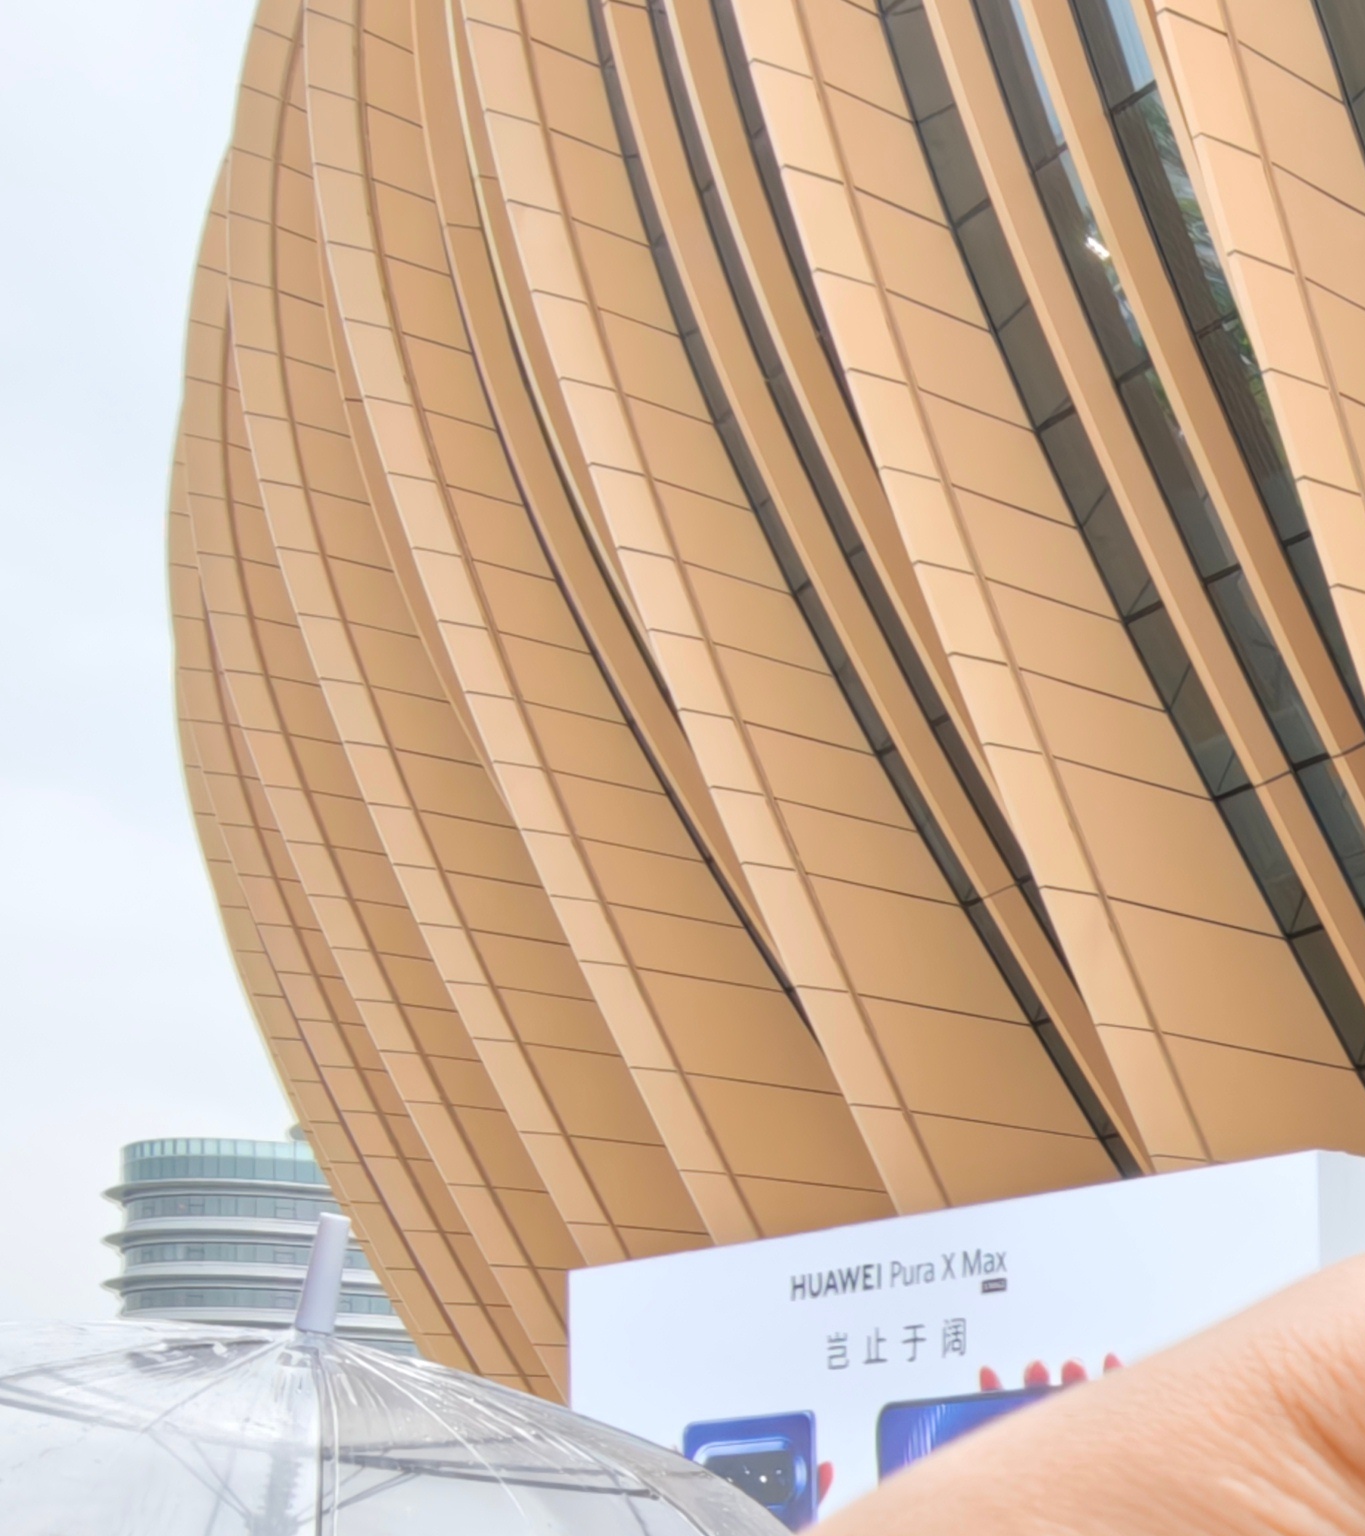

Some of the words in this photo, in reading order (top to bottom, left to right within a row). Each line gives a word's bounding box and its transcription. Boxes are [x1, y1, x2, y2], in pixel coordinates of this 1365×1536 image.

[790, 1263, 882, 1301] HUAWEI
[890, 1261, 935, 1287] Pura
[941, 1252, 956, 1281] X
[961, 1248, 1007, 1278] Max
[826, 1317, 967, 1370] 岂止于阔
